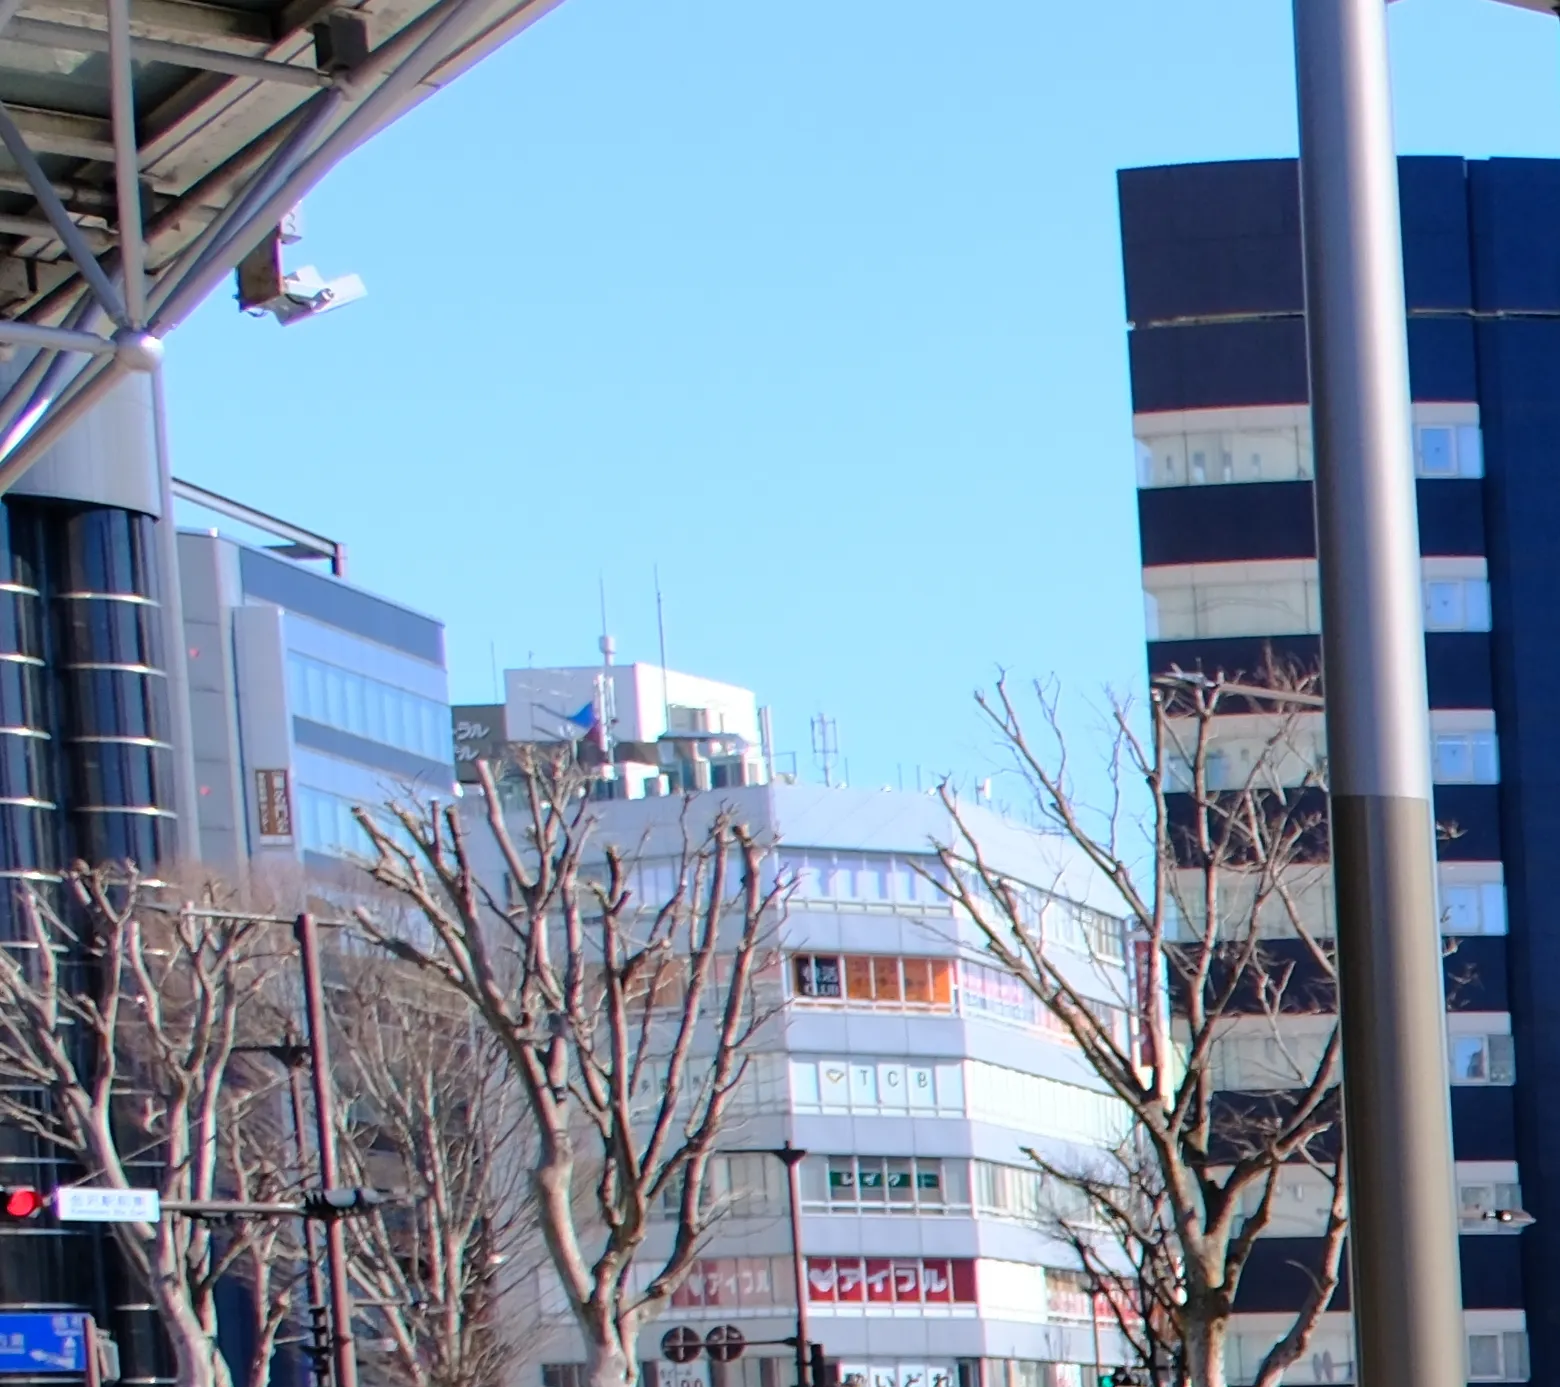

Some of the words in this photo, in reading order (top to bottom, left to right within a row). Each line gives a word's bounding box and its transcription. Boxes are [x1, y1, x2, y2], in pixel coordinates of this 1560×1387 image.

[860, 1069, 928, 1088] TCB
[706, 1269, 771, 1296] アイフル
[838, 1267, 948, 1294] アイフル
